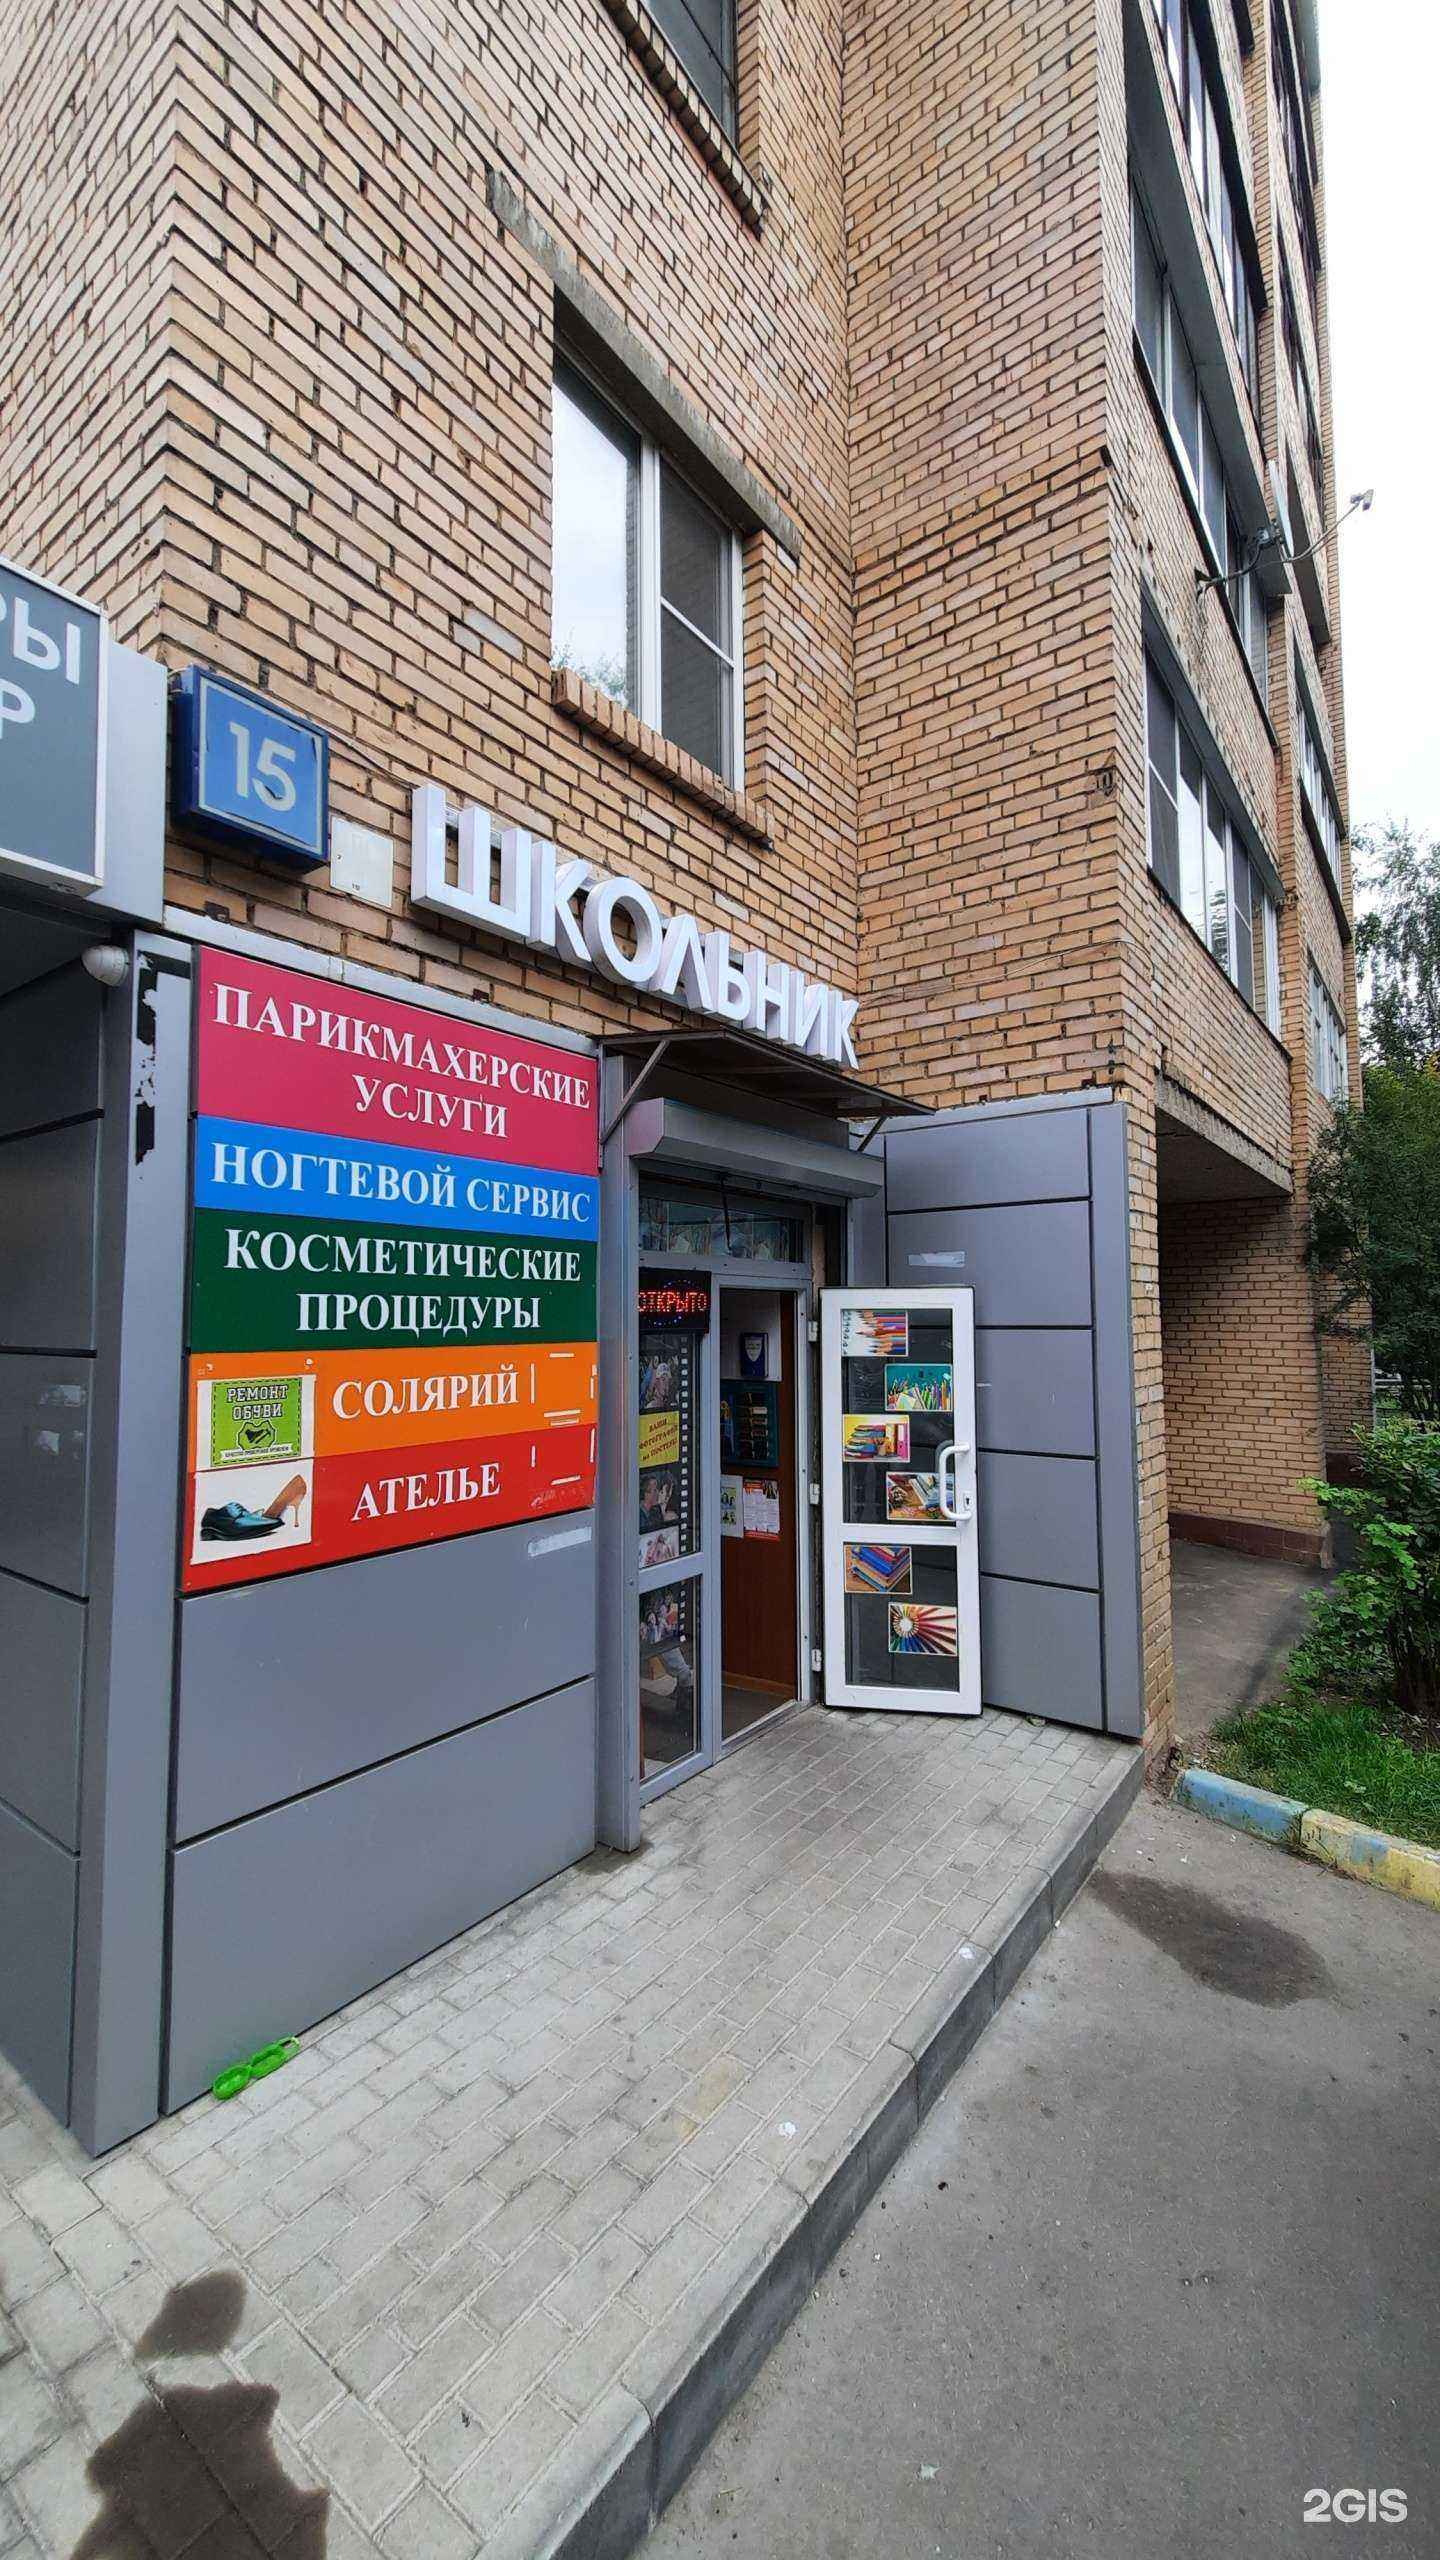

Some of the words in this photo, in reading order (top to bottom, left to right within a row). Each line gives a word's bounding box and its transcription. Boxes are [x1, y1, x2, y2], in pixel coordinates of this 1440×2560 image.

[229, 720, 296, 813] 15
[411, 782, 861, 1070] ШКОЛЬНИК
[211, 982, 591, 1110] ПАРИКМАХЕРСКИЕ
[352, 1074, 509, 1139] УСЛУГИ
[210, 1141, 456, 1209] НОГТЕВОЙ
[465, 1177, 592, 1223] СЕРВИС
[223, 1228, 582, 1283] КОСМЕТИЧЕСКИЕ
[295, 1293, 542, 1339] ПРОЦЕДУРЫ
[637, 1291, 709, 1313] ОТКРЫТО
[226, 1384, 289, 1403] РЕМОНТ
[232, 1402, 284, 1421] ОБУВИ
[331, 1363, 520, 1420] СОЛЯРИЙ
[351, 1462, 501, 1522] АТЕЛЬЕ
